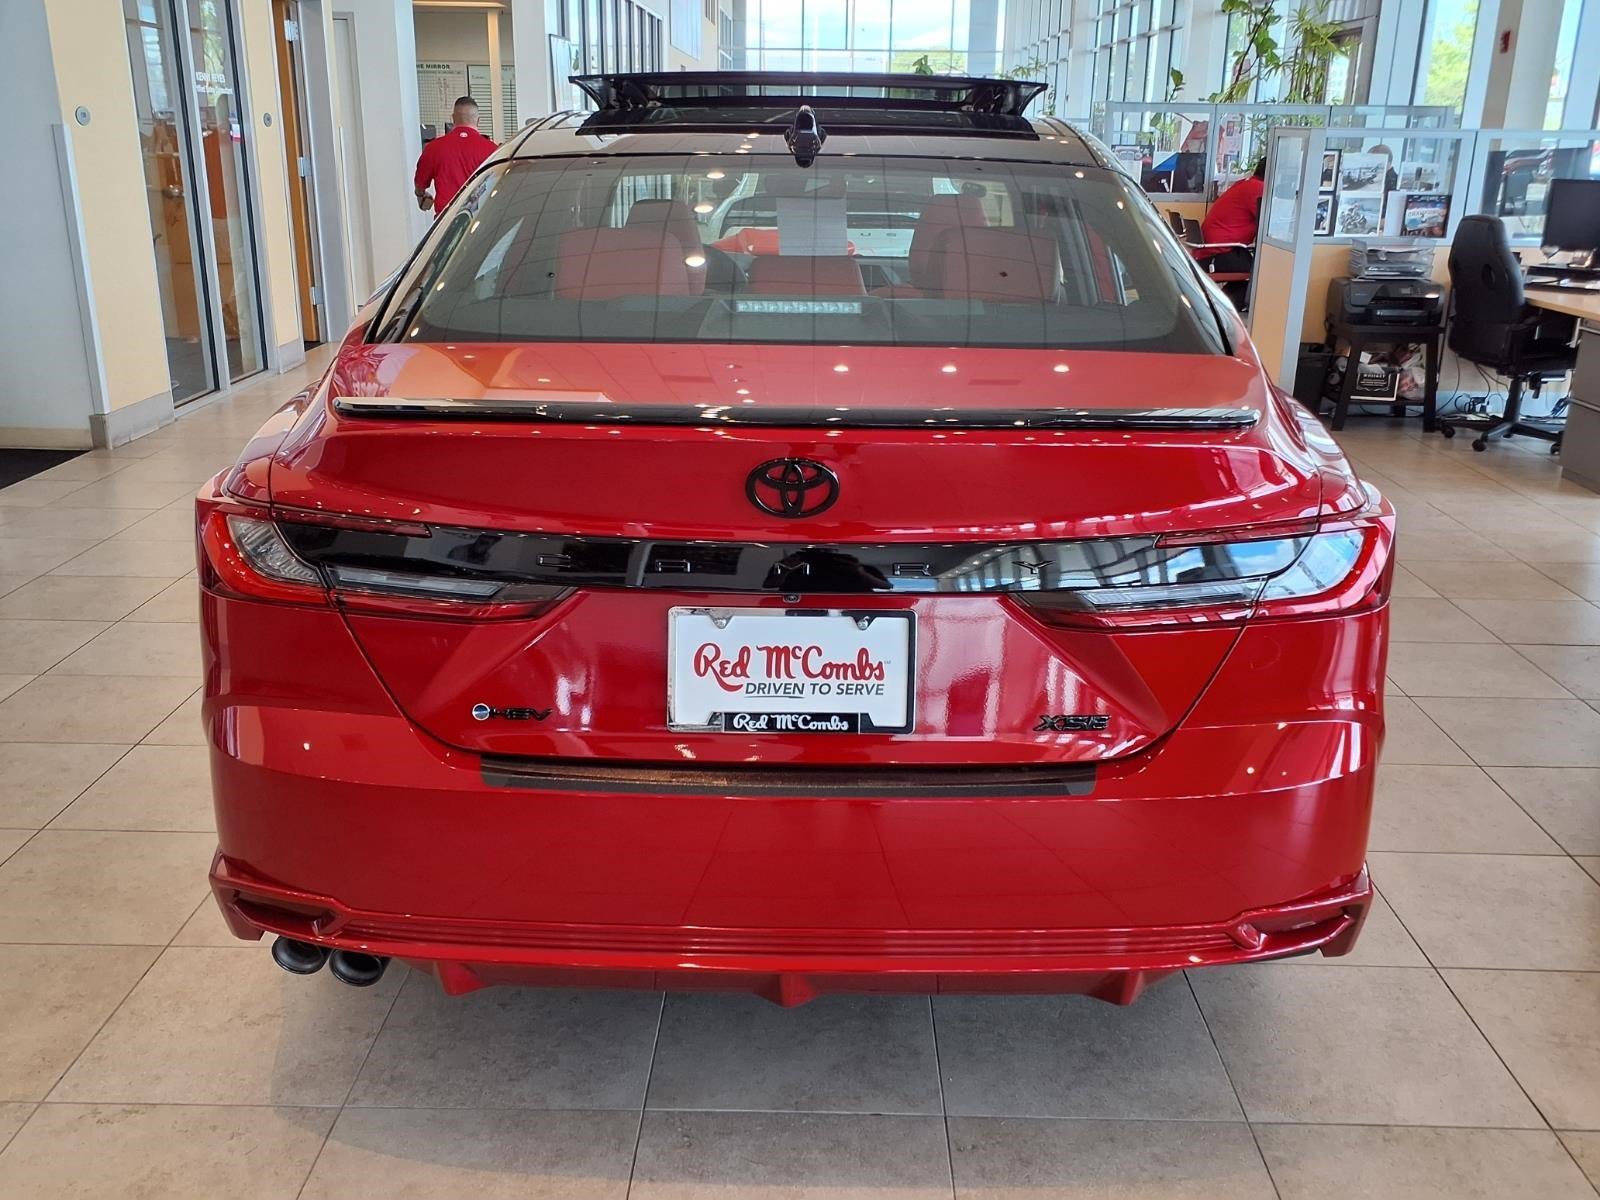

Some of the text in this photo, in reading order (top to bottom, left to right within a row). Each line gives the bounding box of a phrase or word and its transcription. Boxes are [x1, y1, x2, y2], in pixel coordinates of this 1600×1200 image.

[693, 643, 885, 692] Red McCombs
[744, 682, 885, 696] DRIVEN TO SERVE
[732, 713, 849, 731] Red McCombs
